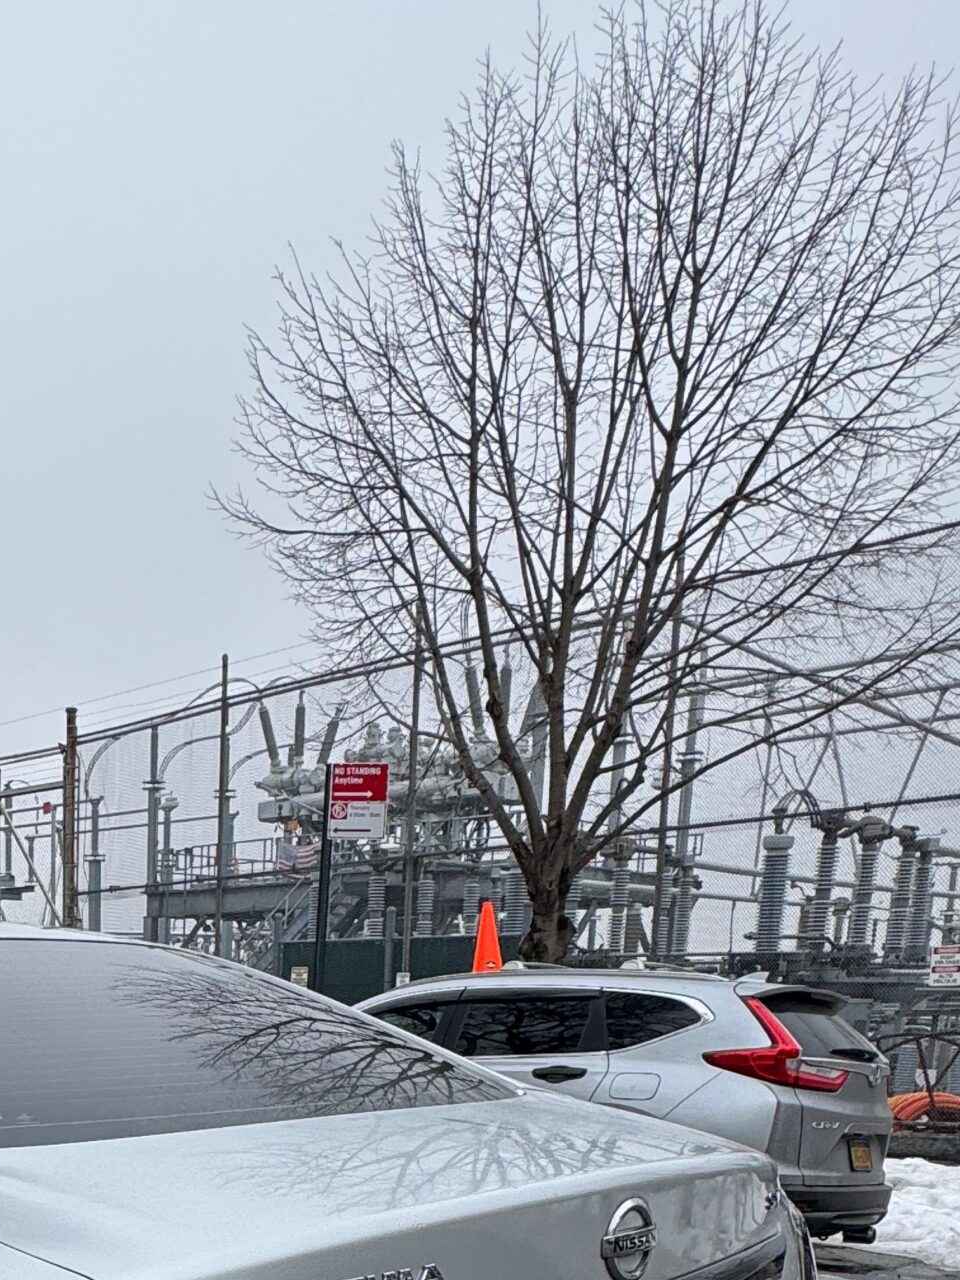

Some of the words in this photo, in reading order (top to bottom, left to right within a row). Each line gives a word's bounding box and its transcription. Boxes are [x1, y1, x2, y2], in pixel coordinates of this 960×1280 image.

[334, 767, 345, 775] NO
[346, 767, 381, 775] STANDING
[334, 776, 364, 785] Anytime
[613, 1231, 656, 1253] NISSAN
